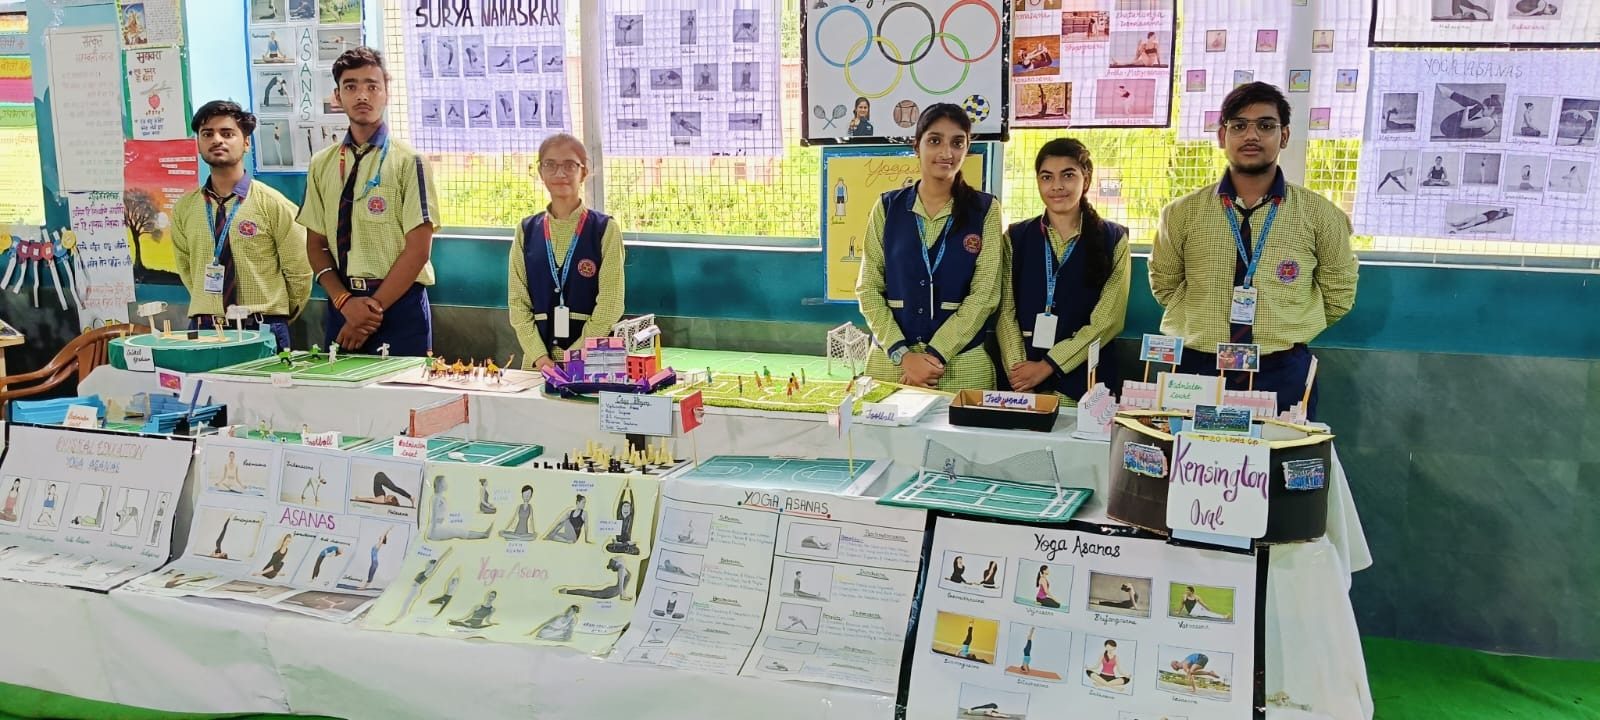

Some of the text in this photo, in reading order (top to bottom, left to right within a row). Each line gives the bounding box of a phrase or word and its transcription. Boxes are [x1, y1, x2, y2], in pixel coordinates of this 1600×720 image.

[416, 1, 560, 27] SURYA NAMASKAR
[300, 28, 313, 121] ASANAS
[1464, 61, 1523, 79] ASANAS
[864, 157, 921, 187] Yogas
[303, 434, 333, 446] Football
[1169, 435, 1268, 502] Kensington
[744, 490, 829, 515] YOGA ASANAS
[1191, 499, 1224, 530] Oval
[280, 508, 335, 530] ASANAS
[1034, 533, 1121, 561] Yoga Asanas
